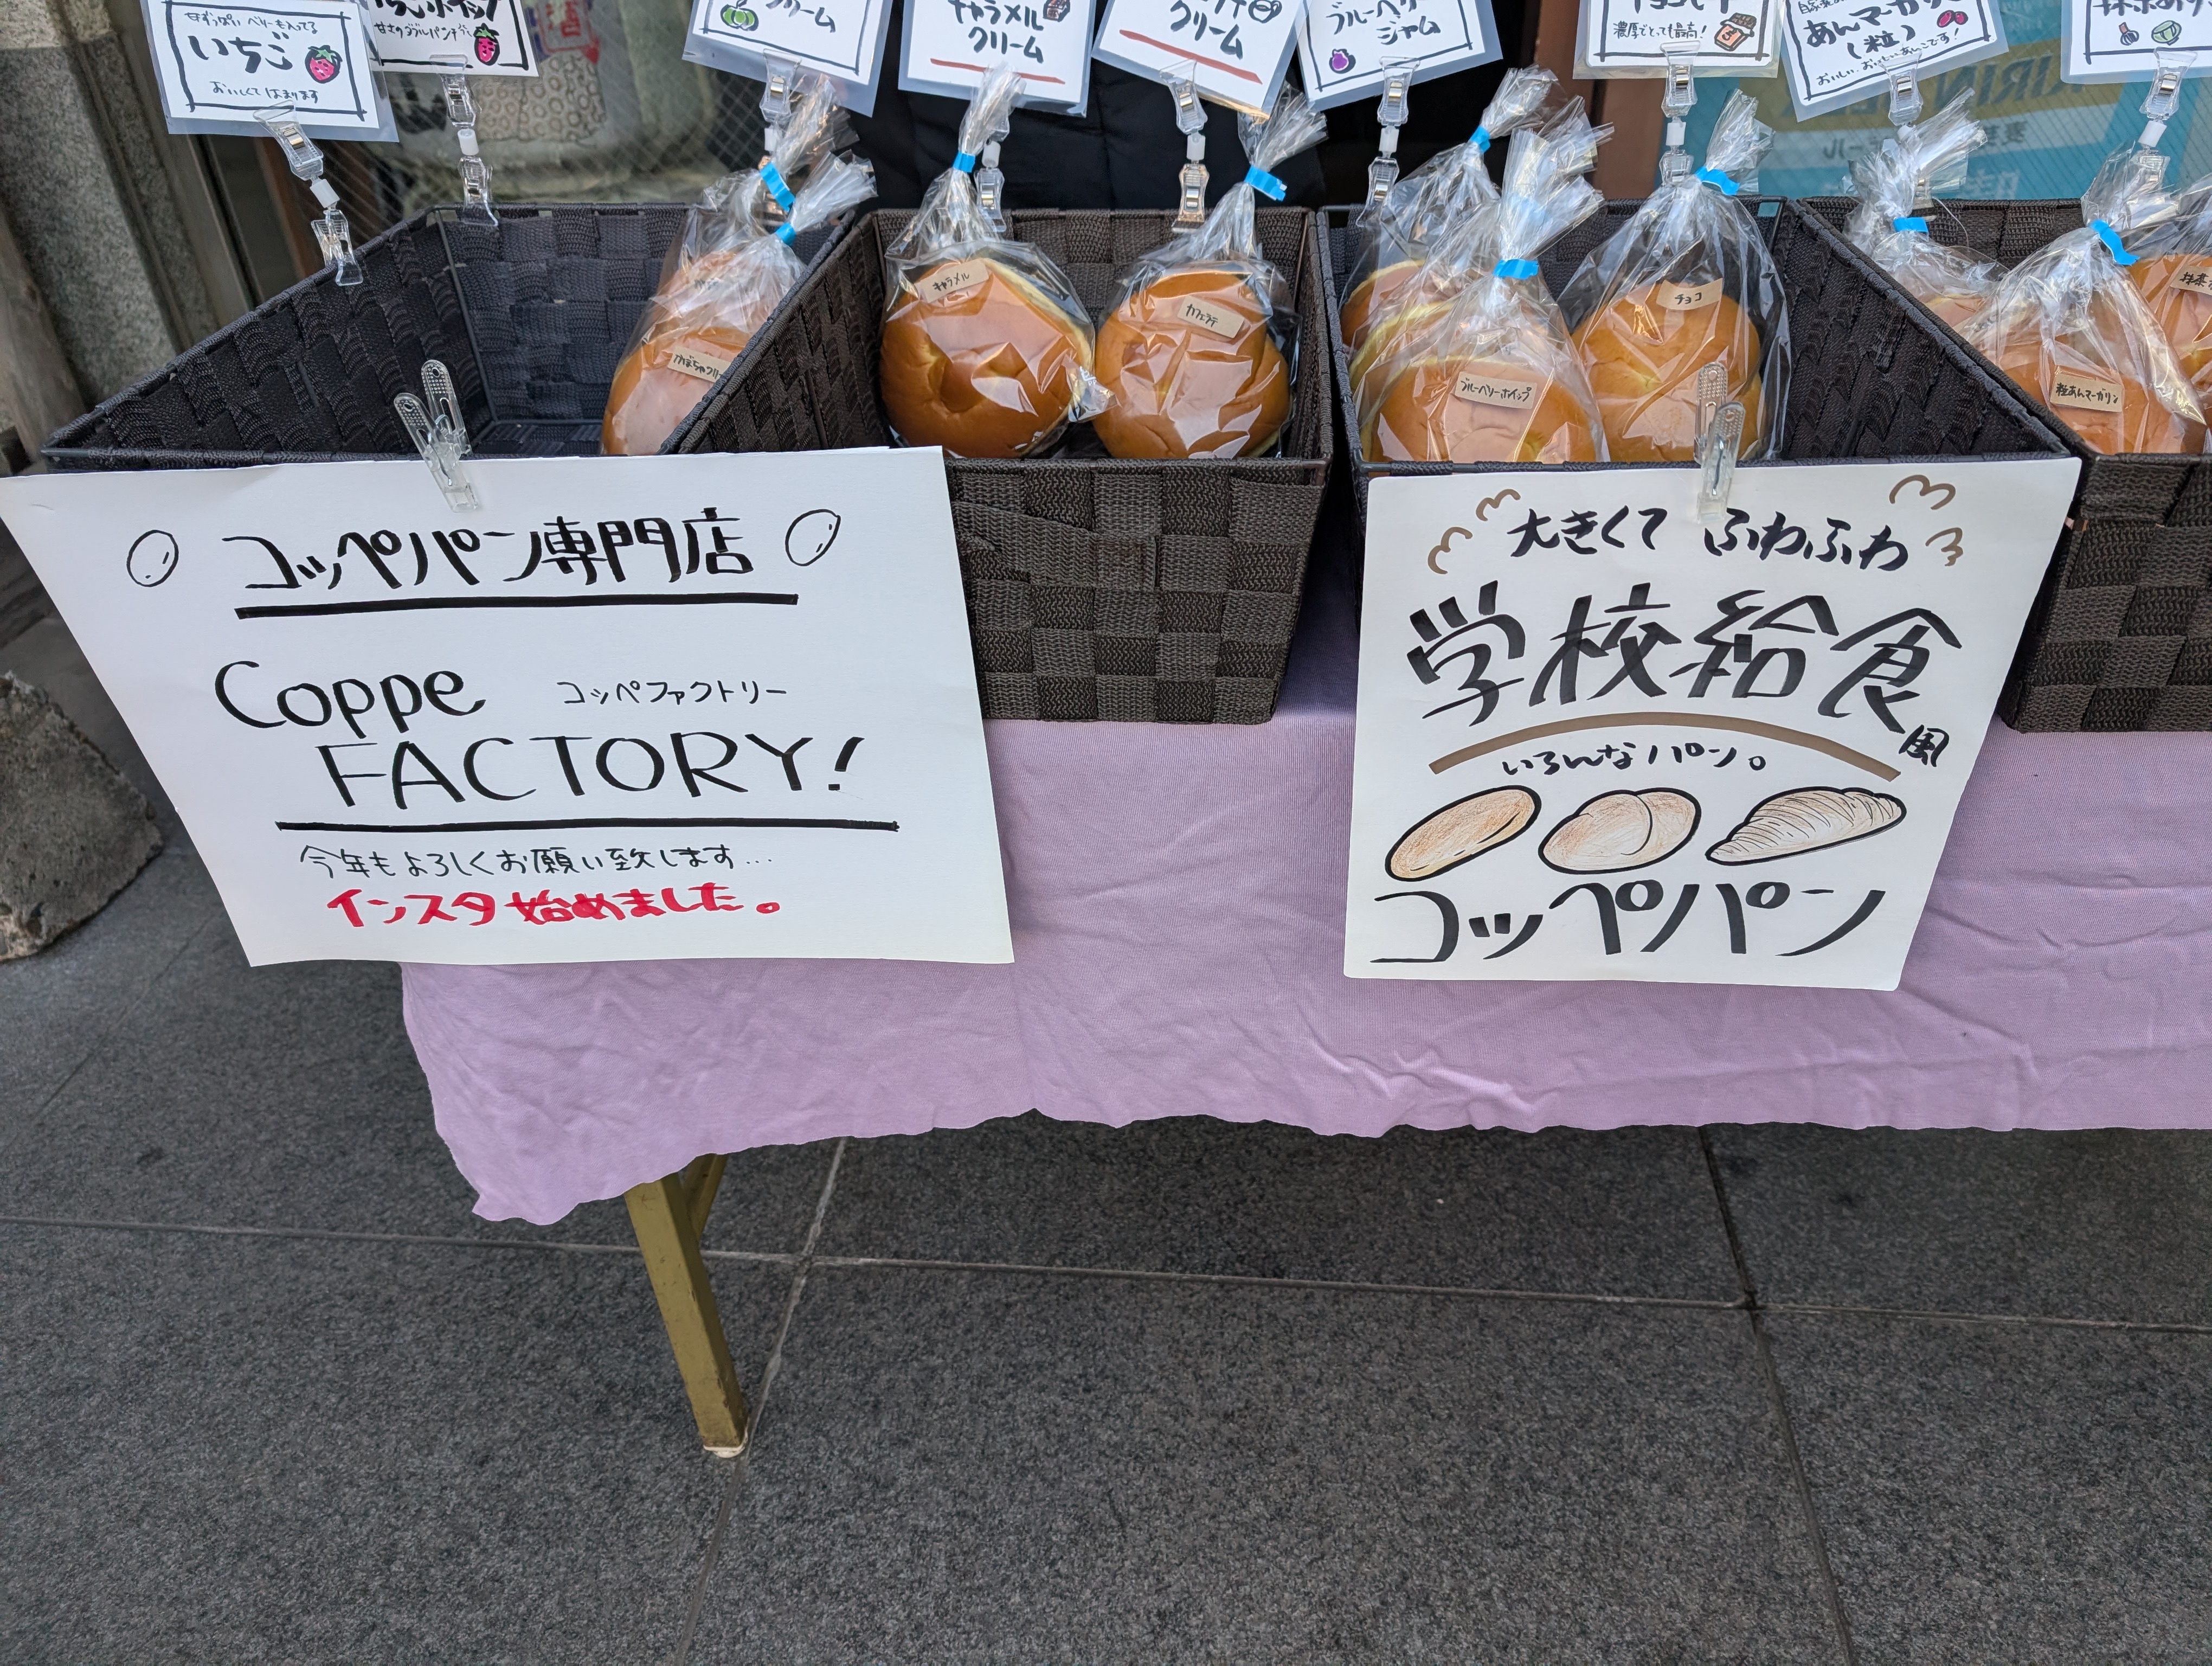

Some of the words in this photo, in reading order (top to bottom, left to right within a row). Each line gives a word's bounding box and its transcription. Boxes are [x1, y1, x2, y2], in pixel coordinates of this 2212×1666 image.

[968, 26, 1044, 63] クリーム
[1170, 0, 1243, 60] クリーム
[1376, 15, 1441, 45] ジャム
[188, 31, 293, 74] いちご
[933, 273, 969, 291] キャラメル
[1675, 292, 1702, 305] チョコ
[1186, 304, 1218, 328] カフェラテ
[1461, 377, 1532, 402] ブルーベリーホイップ
[2056, 382, 2119, 405] 粒あんマーガリン
[222, 507, 754, 590] コッペパン専門店
[1507, 505, 1668, 558] 大きくて
[1704, 508, 1909, 571] ふわふわ
[215, 661, 486, 739] Coppe
[557, 680, 787, 705] コッペファクトリー
[315, 731, 865, 810] FACTORY!
[1370, 879, 1886, 963] コッペパン
